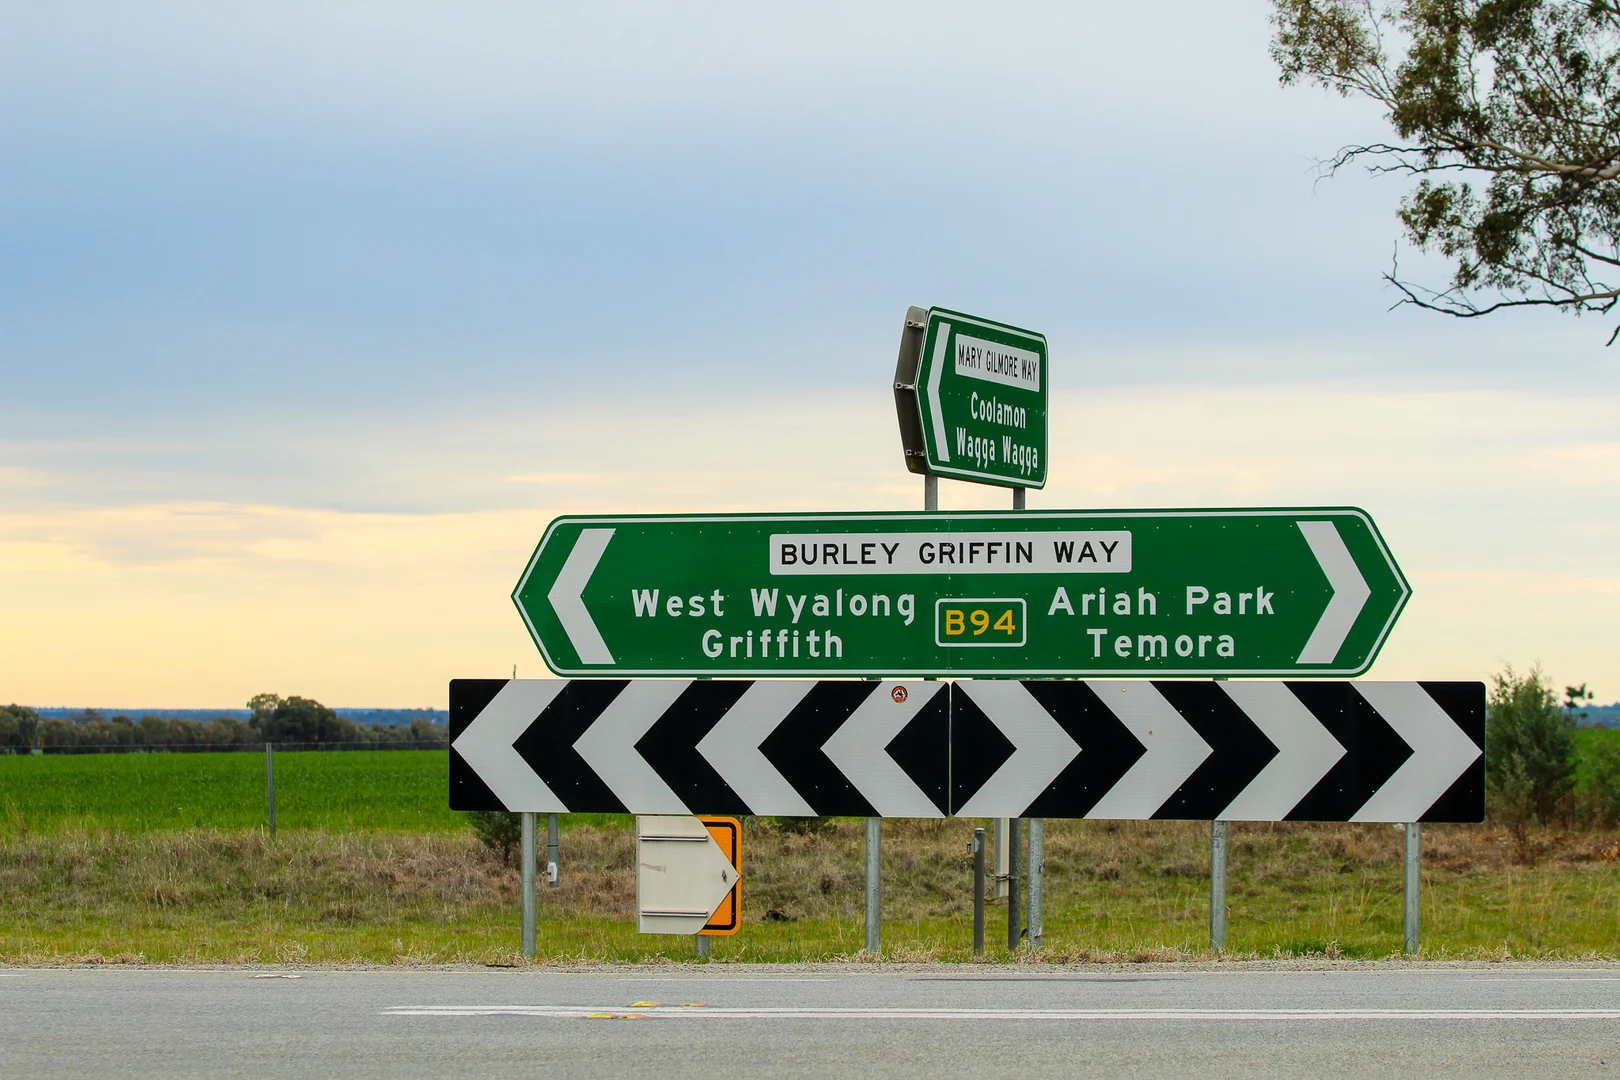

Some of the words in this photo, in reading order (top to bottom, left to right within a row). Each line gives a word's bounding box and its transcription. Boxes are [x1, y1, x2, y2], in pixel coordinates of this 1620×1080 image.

[958, 343, 983, 370] MARY
[986, 351, 1018, 378] GILMORE
[1021, 359, 1037, 382] WAY
[971, 391, 1026, 429] Coolamon
[956, 427, 995, 469] Wagga
[1002, 435, 1038, 476] Wagga
[781, 542, 900, 565] BURLEY
[918, 541, 1034, 564] GRIFFIN
[1053, 540, 1119, 563] WAY
[631, 588, 725, 617] West
[750, 588, 916, 626] Wyalong
[1048, 586, 1157, 616] Ariah
[1186, 585, 1275, 615] Park
[945, 609, 1016, 636] B94
[702, 629, 843, 658] Griffith
[1086, 628, 1235, 658] Temora
